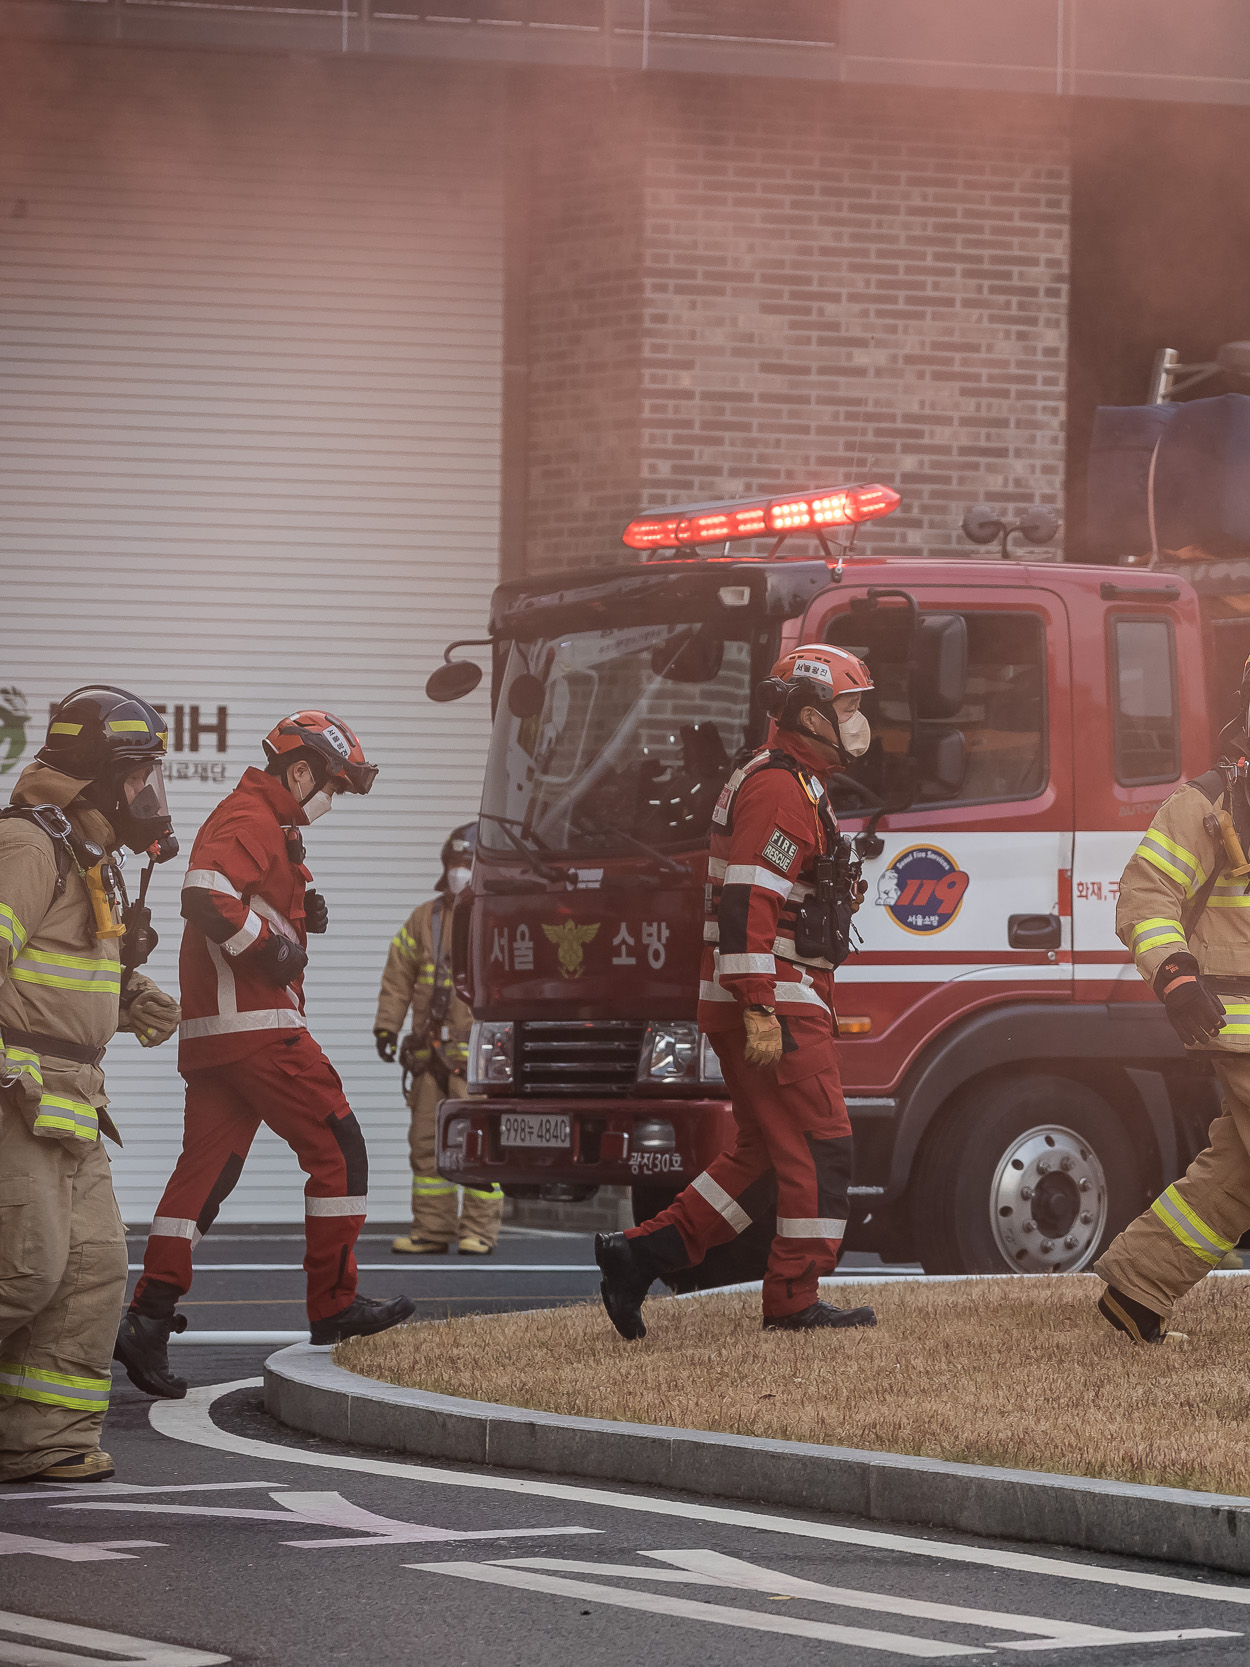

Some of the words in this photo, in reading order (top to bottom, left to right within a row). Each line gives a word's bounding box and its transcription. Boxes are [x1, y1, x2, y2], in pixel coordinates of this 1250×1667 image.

[771, 831, 796, 857] FIRE
[764, 845, 791, 870] RESCUE
[895, 870, 970, 914] 119
[907, 914, 939, 926] 서울소방
[490, 923, 534, 971] 서울
[611, 922, 670, 970] 소방
[628, 1152, 683, 1175] 광진30호
